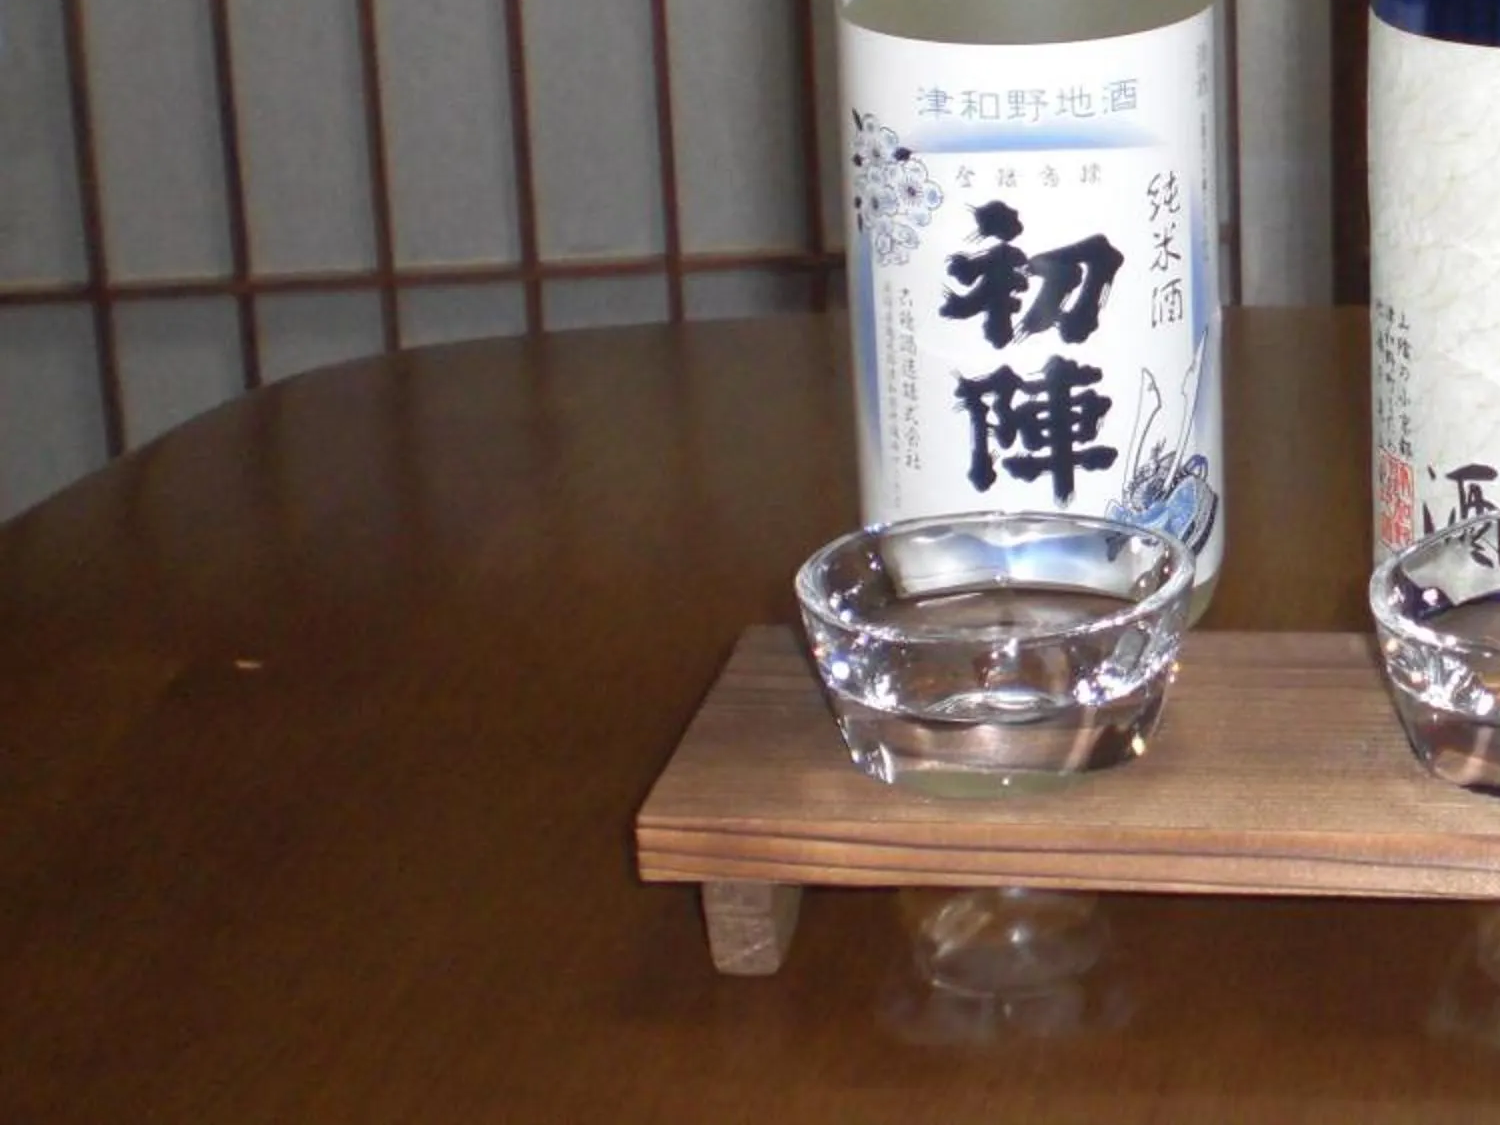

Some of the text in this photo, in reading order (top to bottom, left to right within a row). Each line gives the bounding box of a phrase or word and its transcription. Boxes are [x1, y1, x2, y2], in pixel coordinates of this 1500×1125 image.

[915, 78, 1138, 123] 津和野地酒
[1146, 171, 1184, 328] 純米酒
[939, 200, 1124, 507] 初陣
